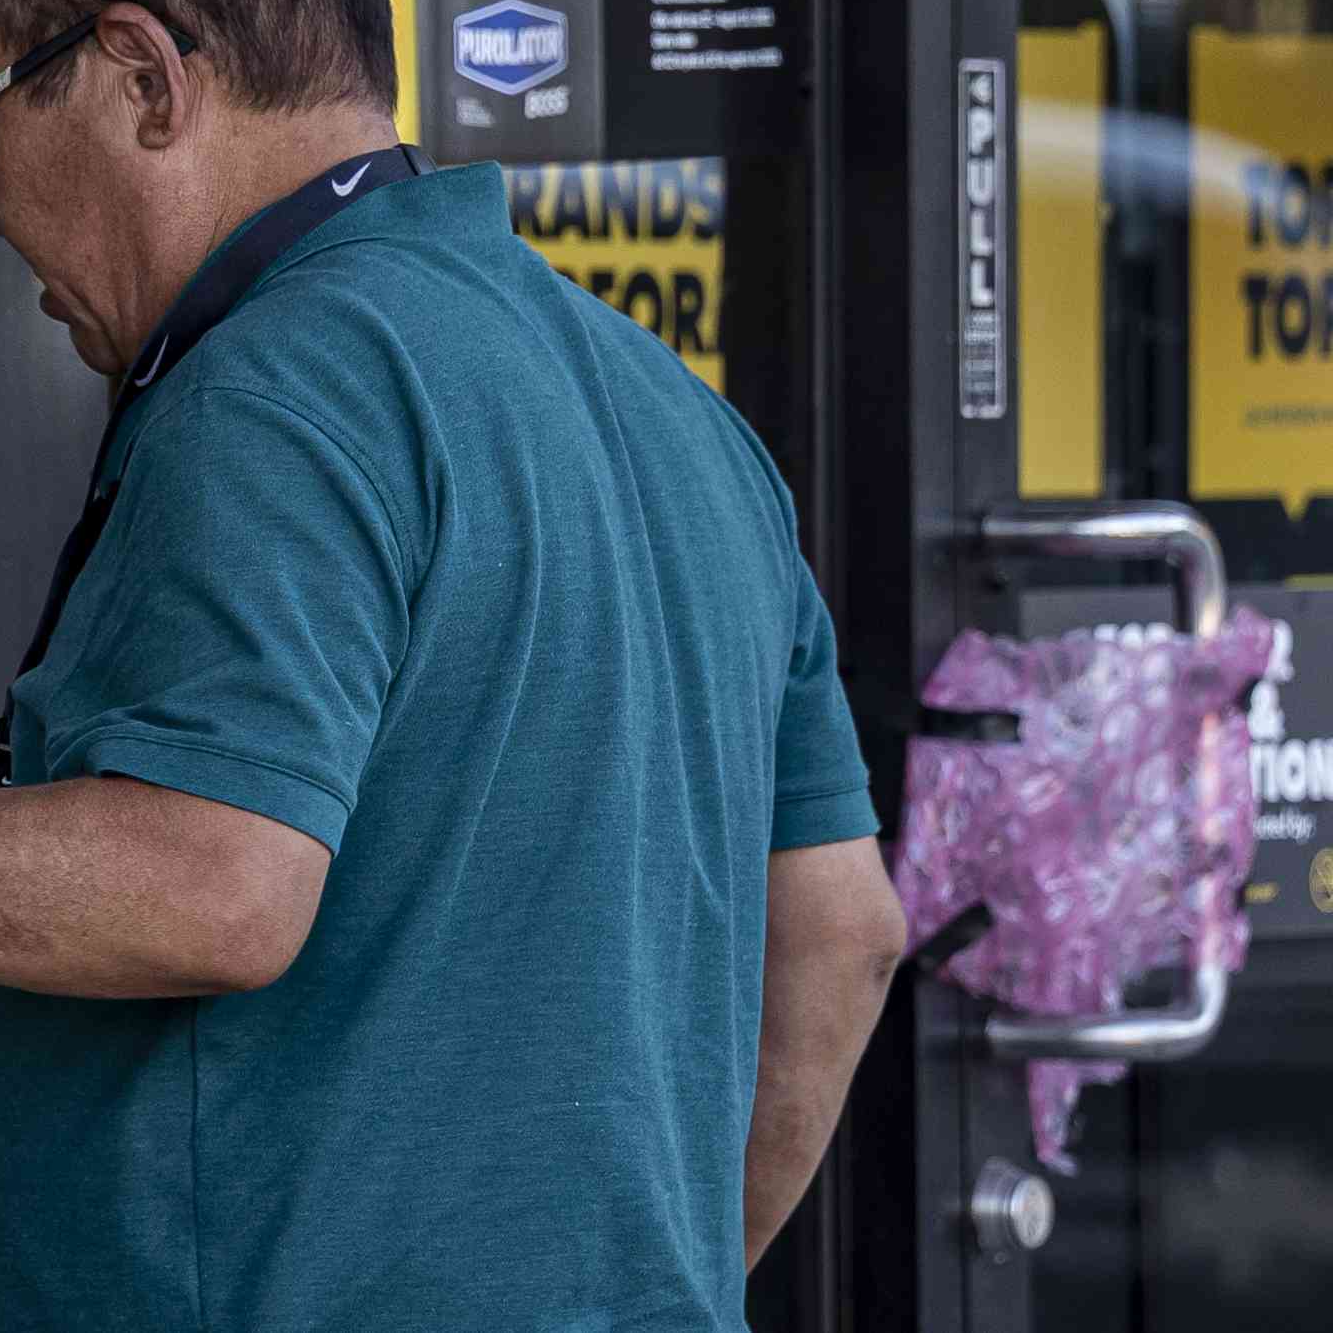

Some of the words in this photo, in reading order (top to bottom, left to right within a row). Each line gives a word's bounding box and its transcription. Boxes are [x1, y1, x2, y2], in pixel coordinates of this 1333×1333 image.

[458, 26, 564, 65] PUROLATOR
[501, 159, 725, 240] RANDS
[966, 108, 996, 307] PULL
